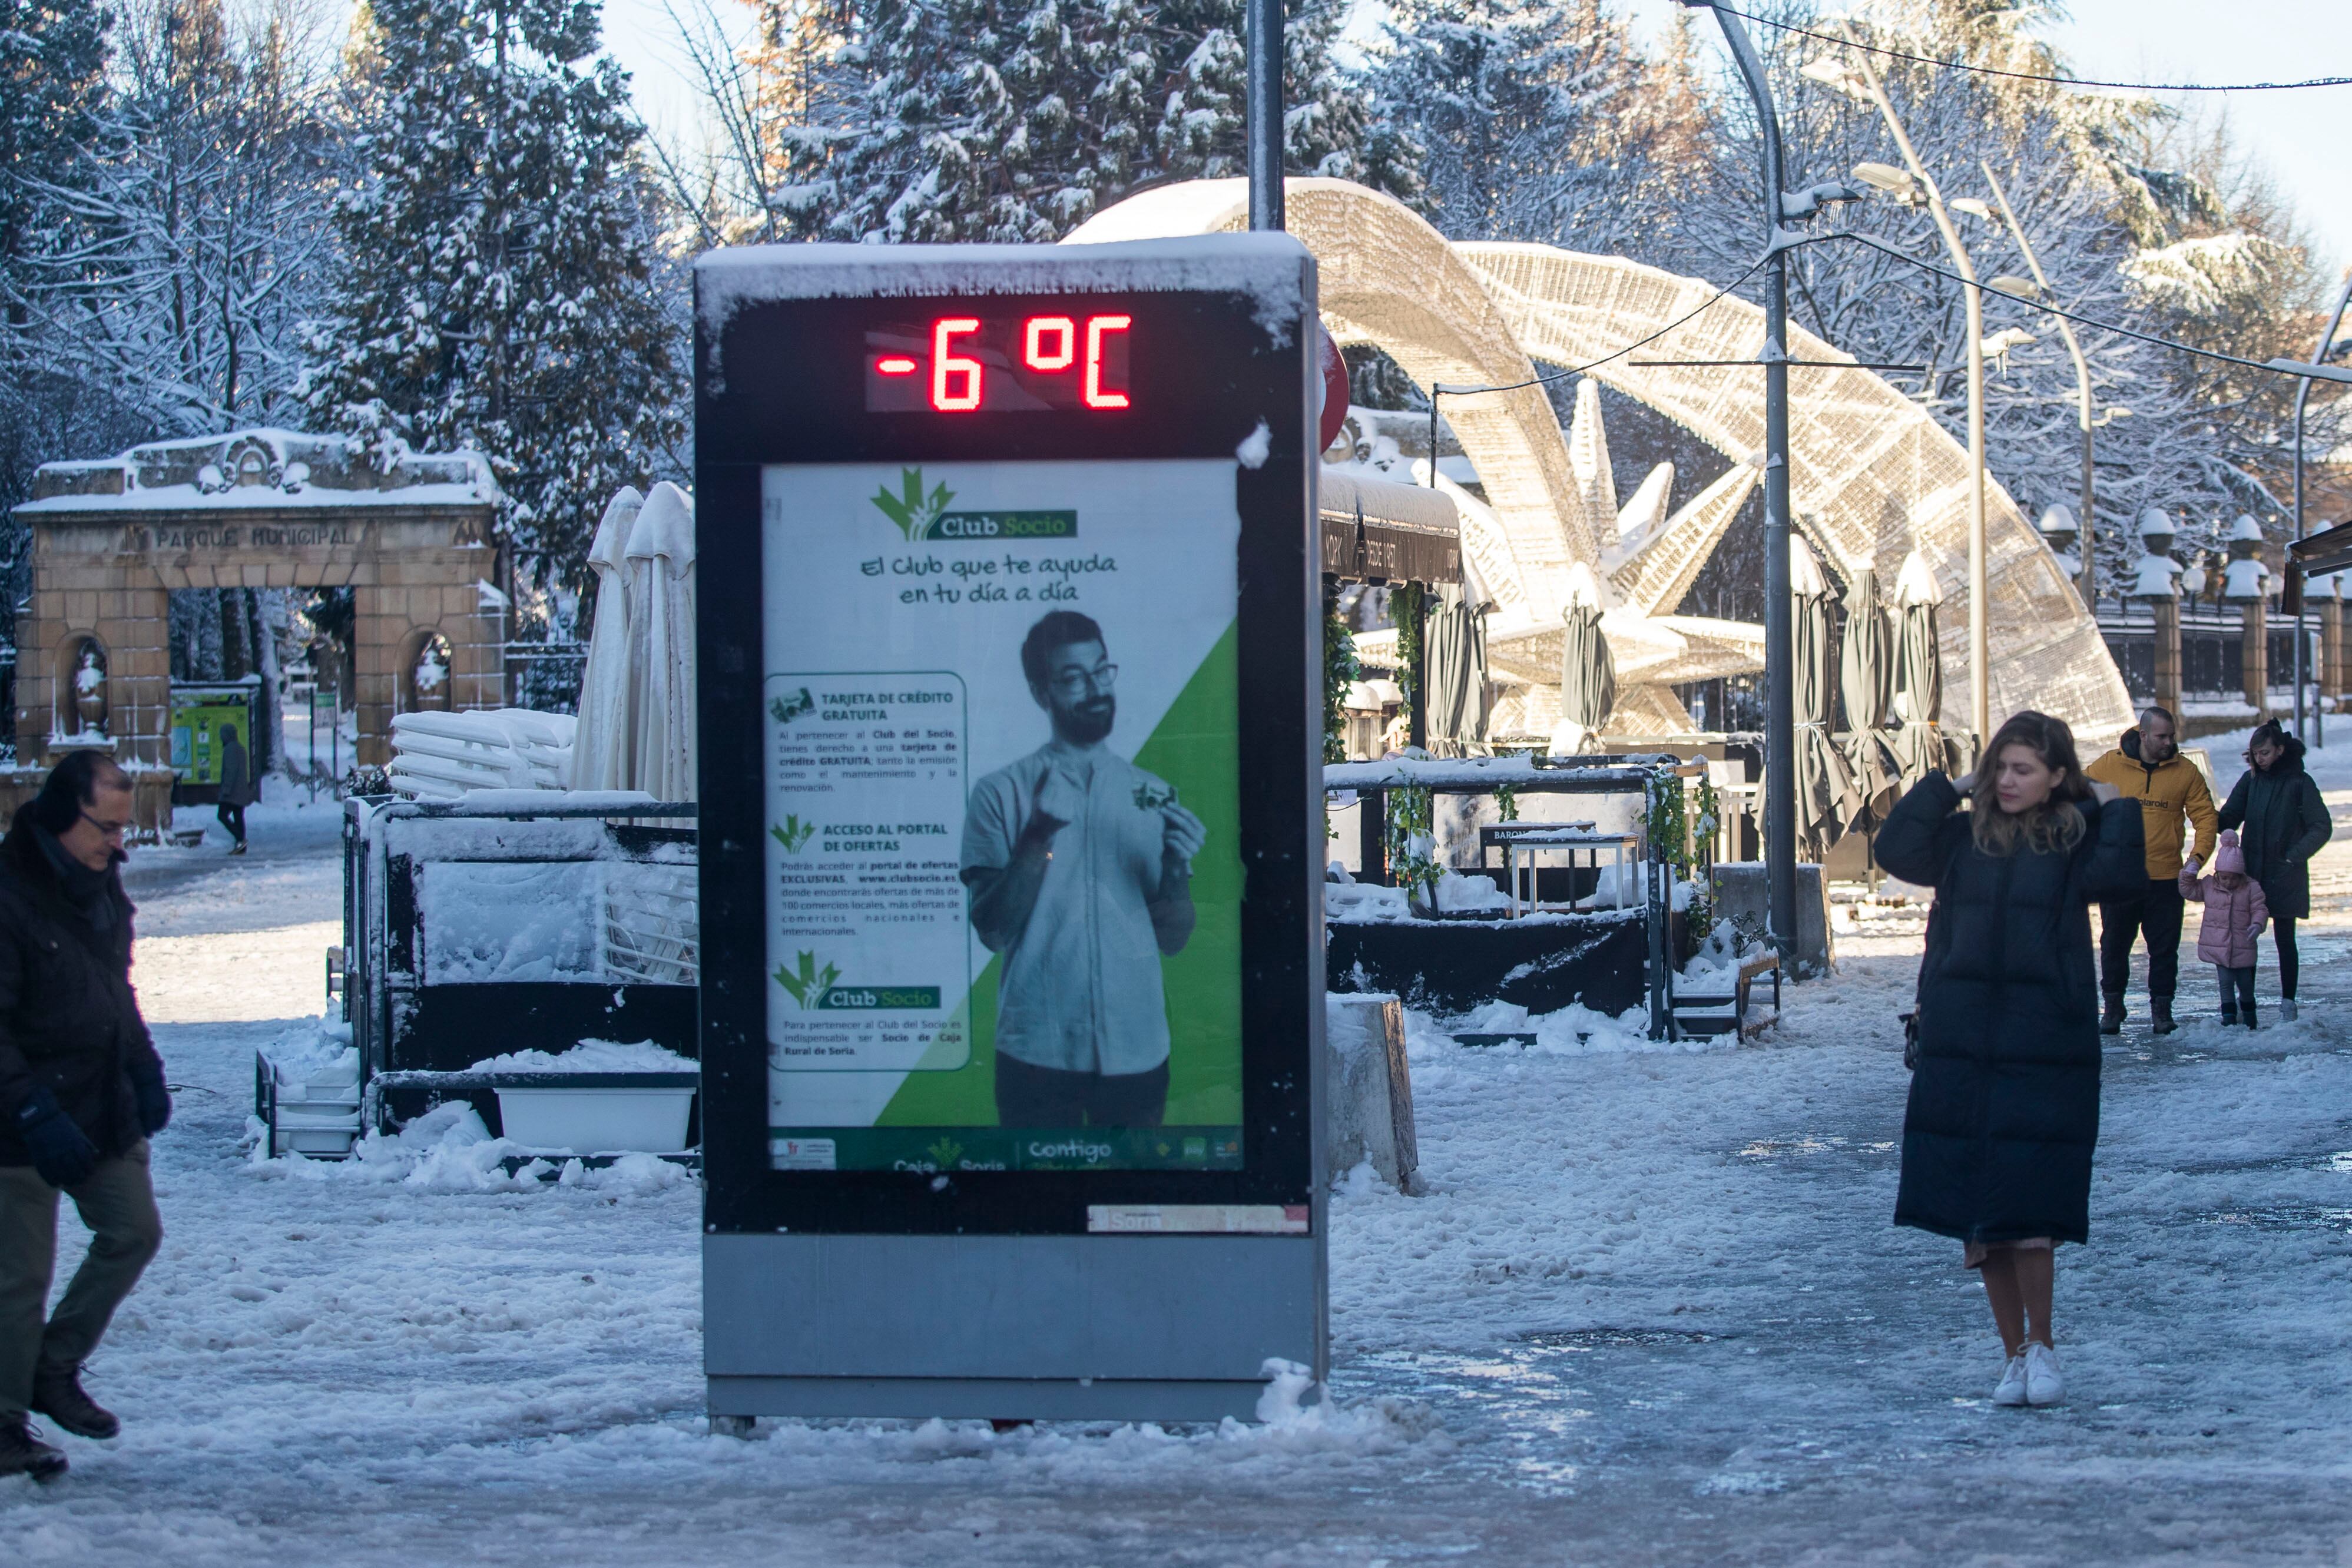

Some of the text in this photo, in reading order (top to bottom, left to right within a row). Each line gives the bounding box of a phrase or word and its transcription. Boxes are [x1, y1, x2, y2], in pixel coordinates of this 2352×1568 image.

[876, 316, 984, 411] -6
[942, 515, 1067, 538] Club Socio
[157, 528, 354, 548] PARQUE MUNICIPAL
[1326, 533, 1343, 566] YORK
[860, 553, 1118, 582] El Club que te ayuda
[899, 580, 1079, 604] en tu día a día
[822, 691, 954, 707] TARJETA DE CRÉDITO
[822, 710, 888, 721] GRATUITA
[779, 731, 789, 740] Al
[795, 732, 849, 742] pertenecer
[856, 730, 866, 740] al
[873, 730, 896, 739] Club
[903, 730, 919, 739] del
[779, 745, 809, 753] tienes
[816, 744, 855, 753] derecho
[875, 744, 895, 752] una
[900, 743, 938, 754] tarjeta
[943, 742, 958, 751] de
[779, 757, 816, 766] crédito
[876, 757, 904, 765] tanto
[906, 755, 916, 765] la
[919, 755, 958, 765] emisión
[780, 767, 958, 781] como el mantenimiento y la
[2139, 798, 2168, 809] olaroid
[824, 824, 949, 836] ACCESO AL PORTAL
[824, 840, 901, 852] DE OFERTAS
[781, 860, 959, 872] Podrás acceder al portal de ofertas
[781, 887, 960, 897] donde encontrarás ofertas de más de
[782, 900, 800, 910] 100
[800, 900, 850, 910] comercios
[889, 900, 910, 909] más
[911, 900, 946, 909] ofertas
[946, 900, 960, 909] de
[781, 912, 960, 923] comercios nacionales e
[829, 990, 933, 1007] Club Socio
[784, 1019, 962, 1032] Para pertenecer al Club del Socio es
[784, 1032, 963, 1045] indispensable ser Socio de Caja
[784, 1046, 812, 1056] Rural
[814, 1046, 827, 1056] de
[1028, 1138, 1112, 1163] Contigo
